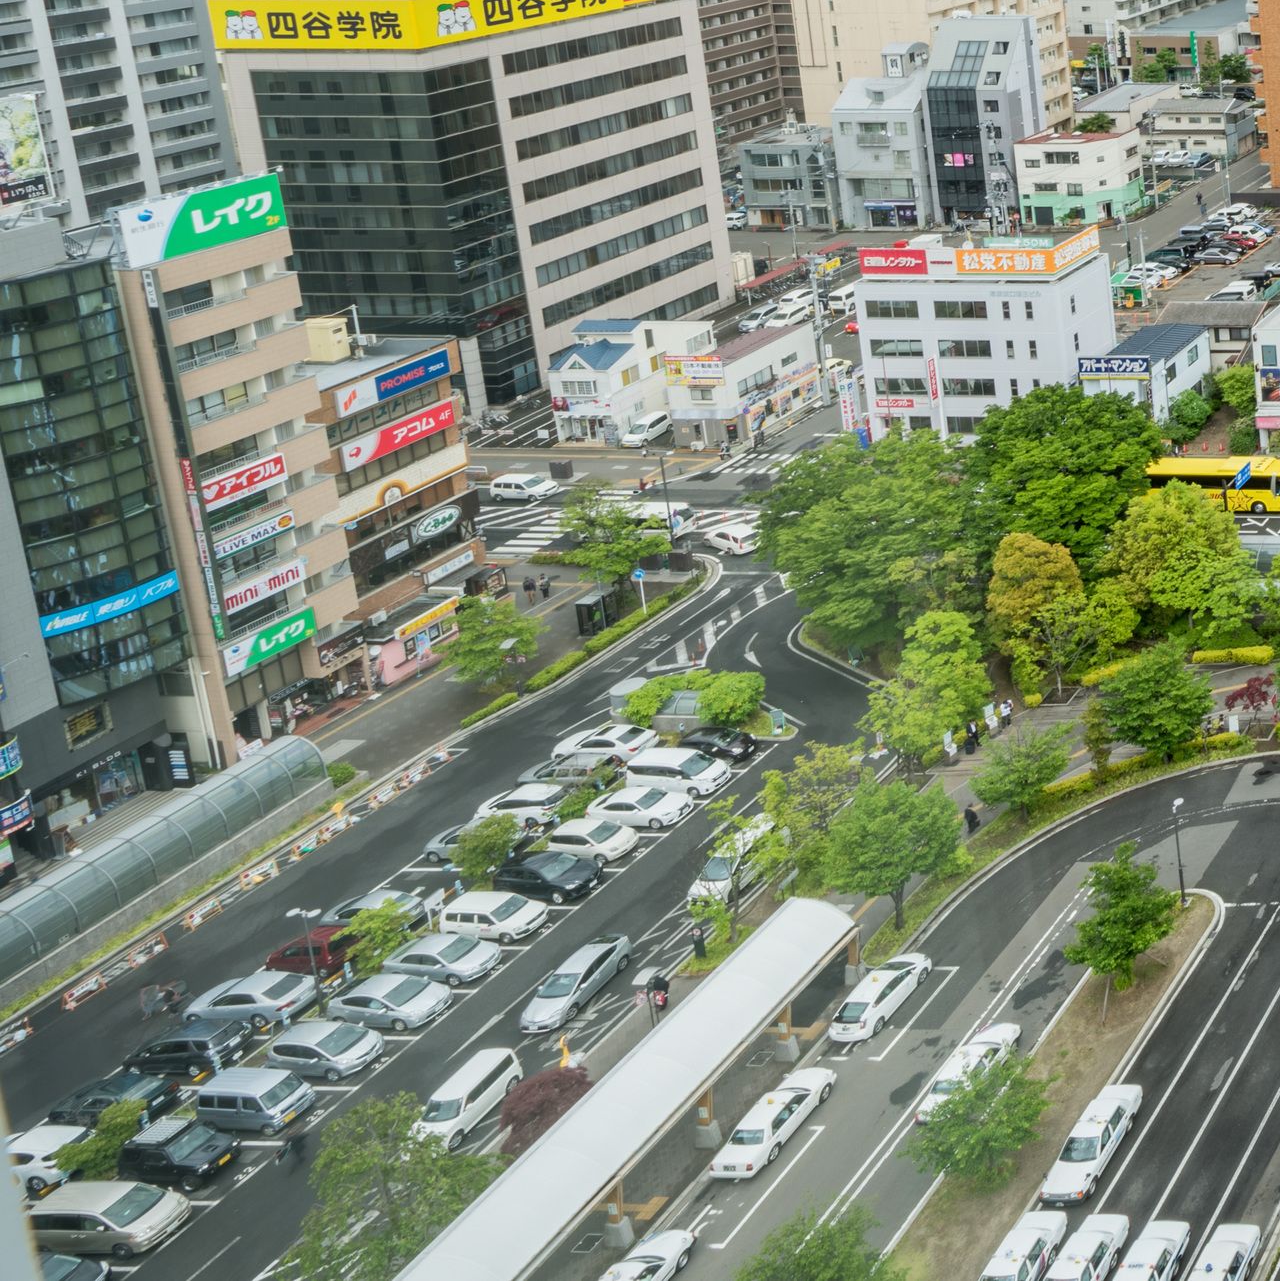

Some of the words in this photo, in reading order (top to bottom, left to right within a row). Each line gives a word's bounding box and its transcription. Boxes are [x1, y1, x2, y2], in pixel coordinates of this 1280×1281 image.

[267, 9, 403, 41] 四谷学院
[191, 190, 272, 234] レイク
[962, 252, 1047, 271] 松栄不動産
[1079, 359, 1147, 372] アパート・マンション
[380, 366, 426, 392] PROMISE
[392, 417, 435, 444] アコム
[219, 461, 281, 494] アイフル
[251, 524, 278, 541] MAX
[259, 618, 306, 652] レイク
[233, 1166, 257, 1181] 22
